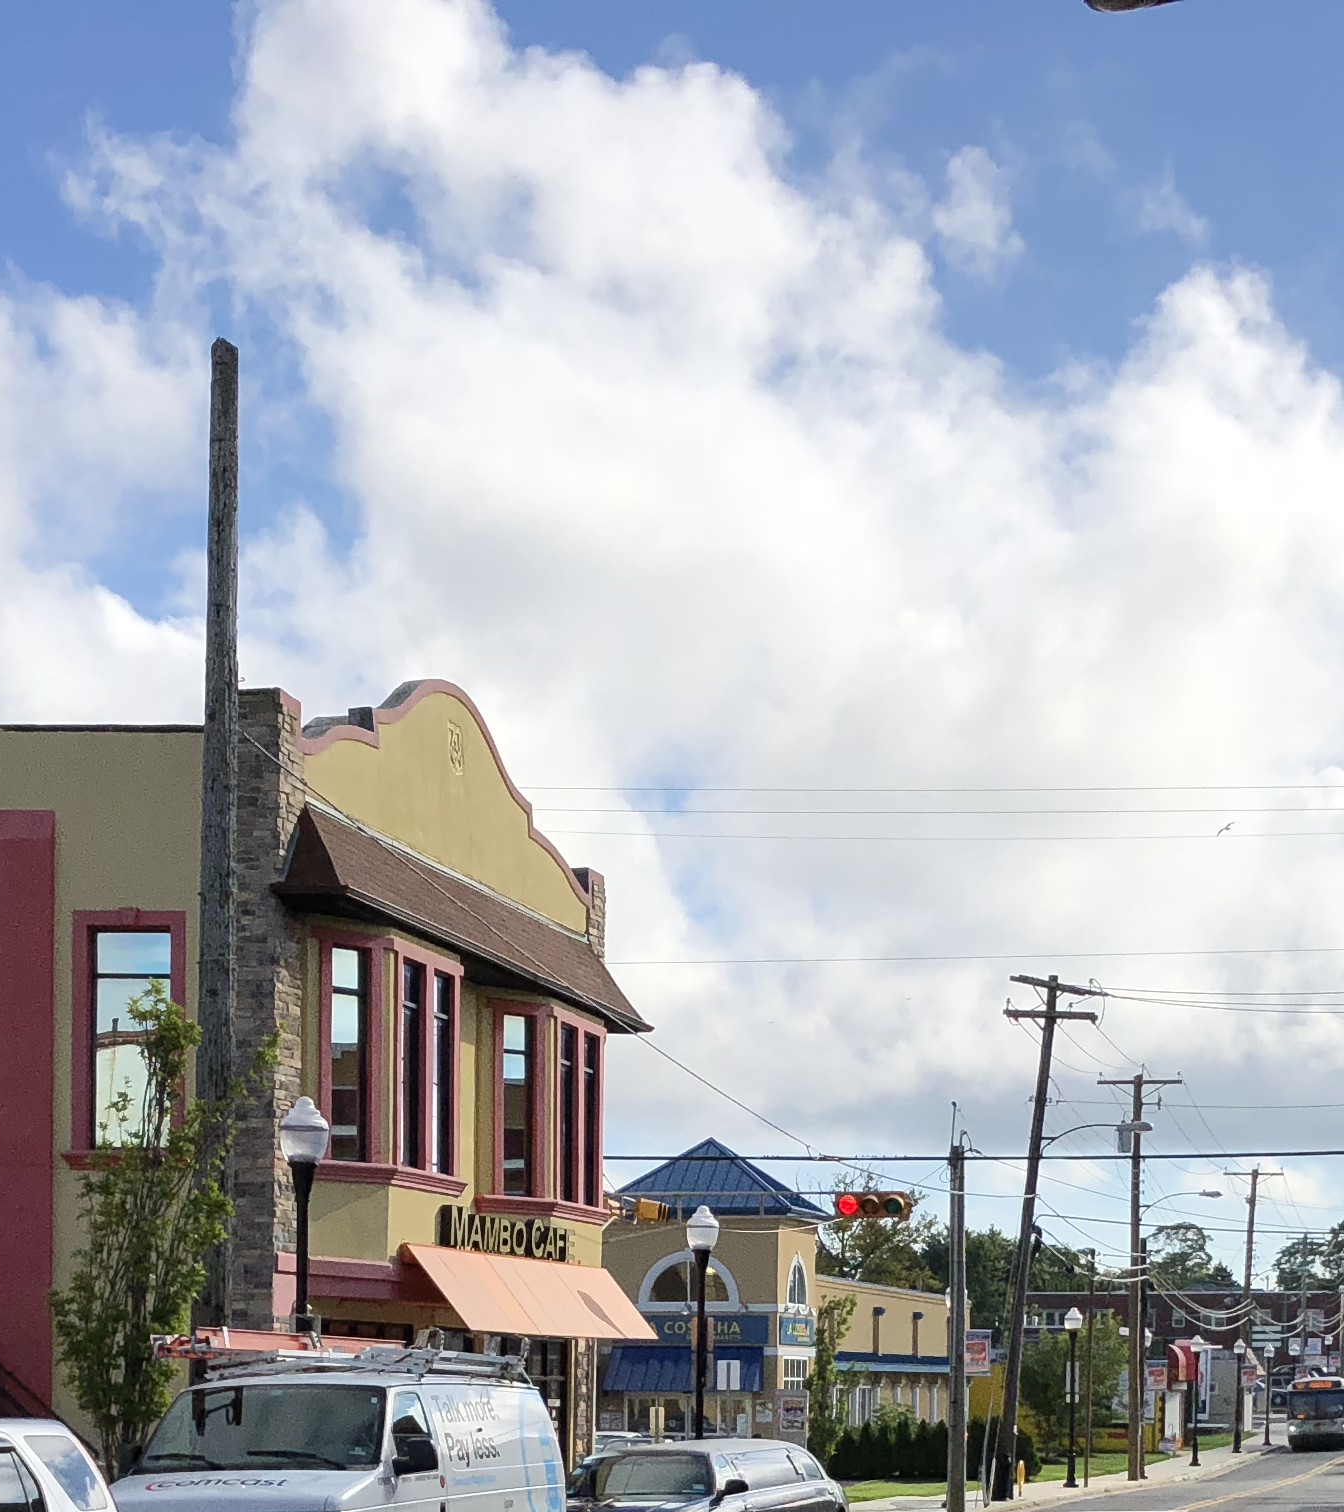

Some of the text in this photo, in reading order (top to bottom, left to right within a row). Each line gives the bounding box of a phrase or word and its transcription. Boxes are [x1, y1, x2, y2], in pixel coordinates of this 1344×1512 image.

[450, 1204, 576, 1263] MAMBO CAFE
[431, 1394, 500, 1423] Talk more.
[444, 1431, 501, 1467] Pay less.
[145, 1478, 288, 1491] comcast
